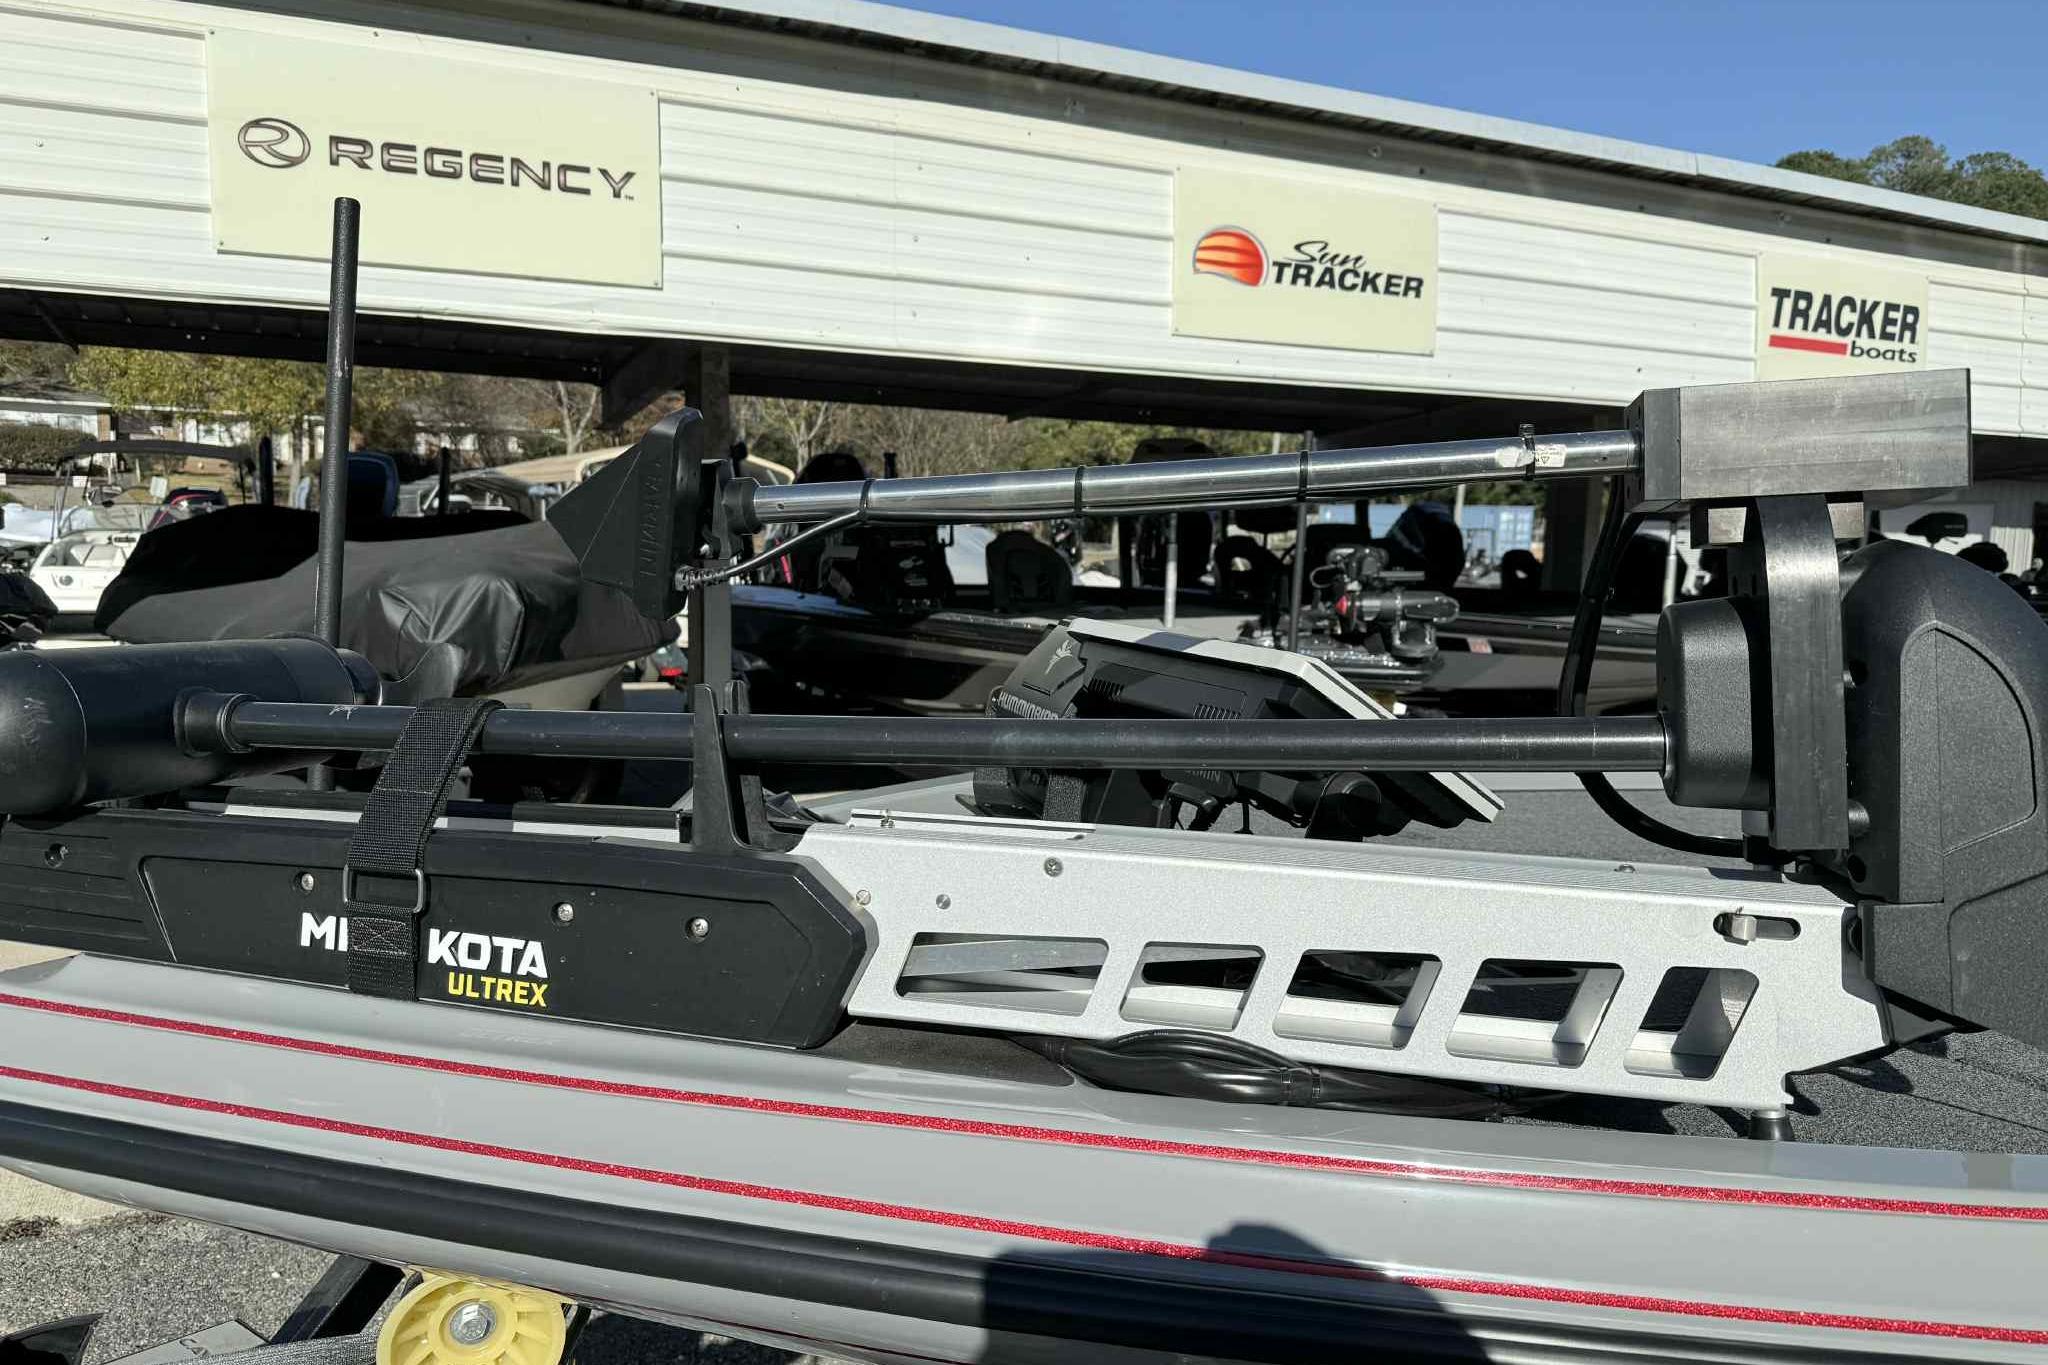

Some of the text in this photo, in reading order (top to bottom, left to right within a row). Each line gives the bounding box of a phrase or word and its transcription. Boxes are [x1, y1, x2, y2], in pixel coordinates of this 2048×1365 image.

[329, 135, 636, 199] REGENCY
[1282, 241, 1366, 269] Sun
[1272, 261, 1424, 298] TRACKER
[1771, 287, 1920, 344] TRACKER
[1850, 340, 1918, 363] boats
[300, 912, 548, 978] MI KOTA
[448, 972, 548, 1007] ULTREX
